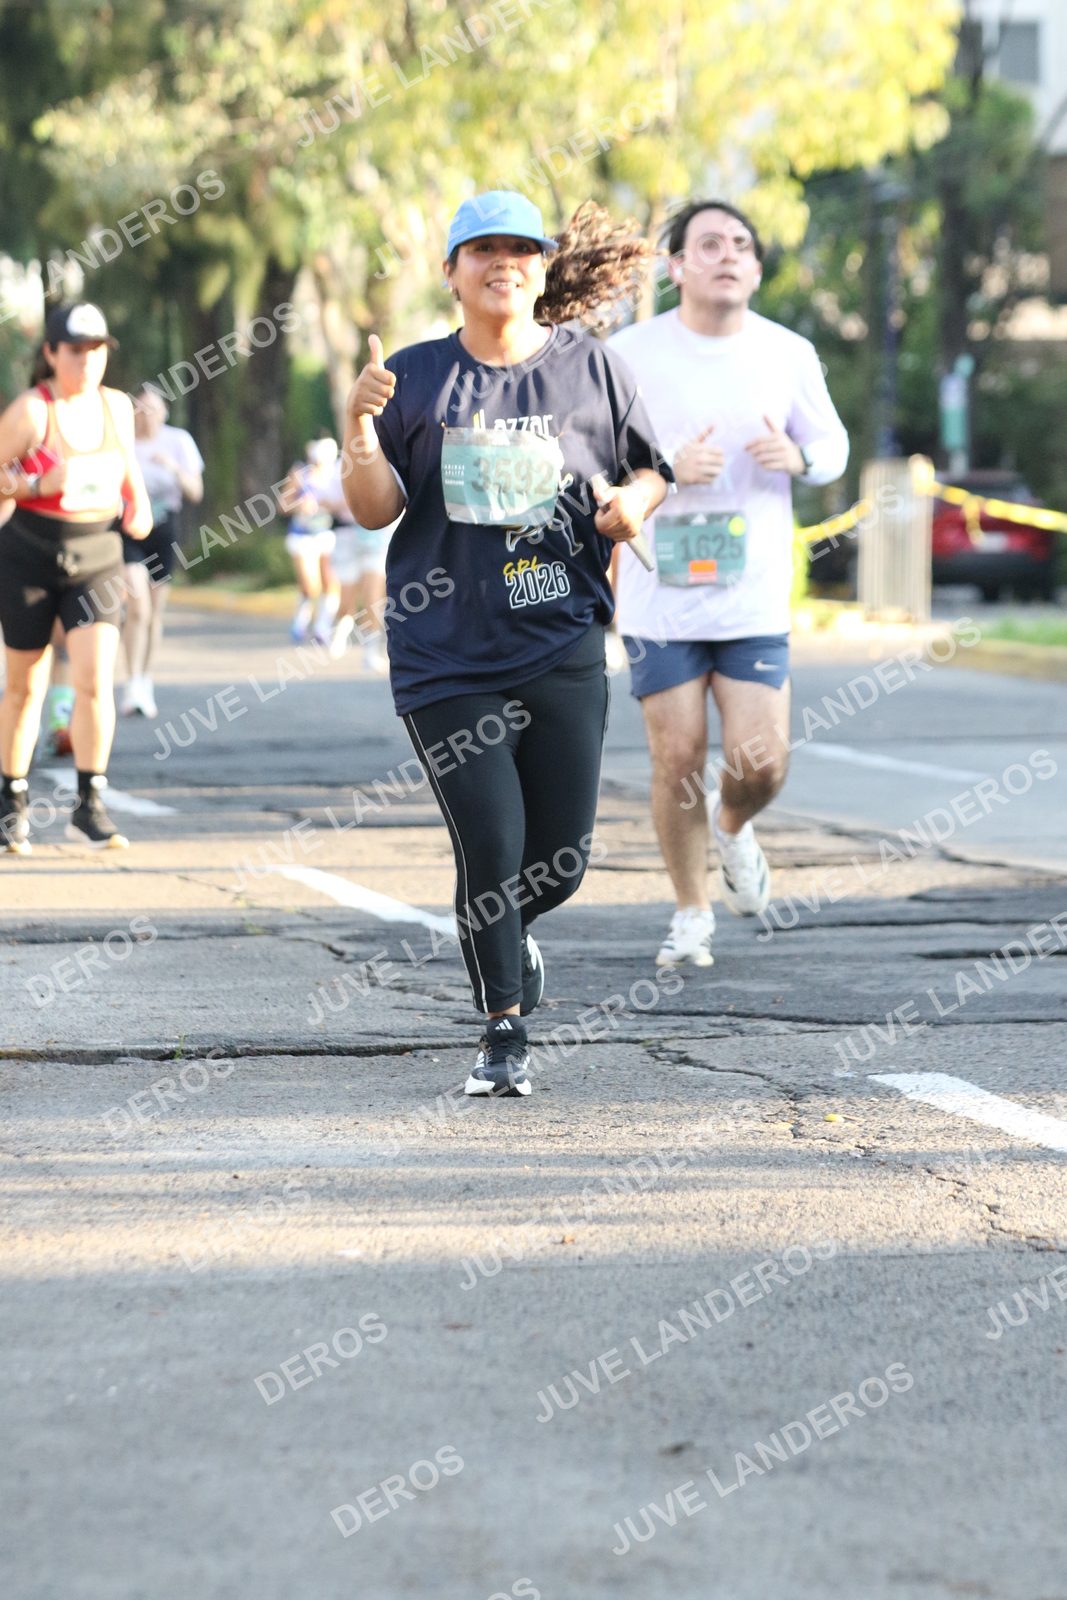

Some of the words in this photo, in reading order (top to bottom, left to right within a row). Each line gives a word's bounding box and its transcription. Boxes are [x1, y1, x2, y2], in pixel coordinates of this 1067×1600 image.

[471, 457, 555, 496] 3592
[680, 532, 744, 561] 1625
[505, 561, 571, 609] 2026
